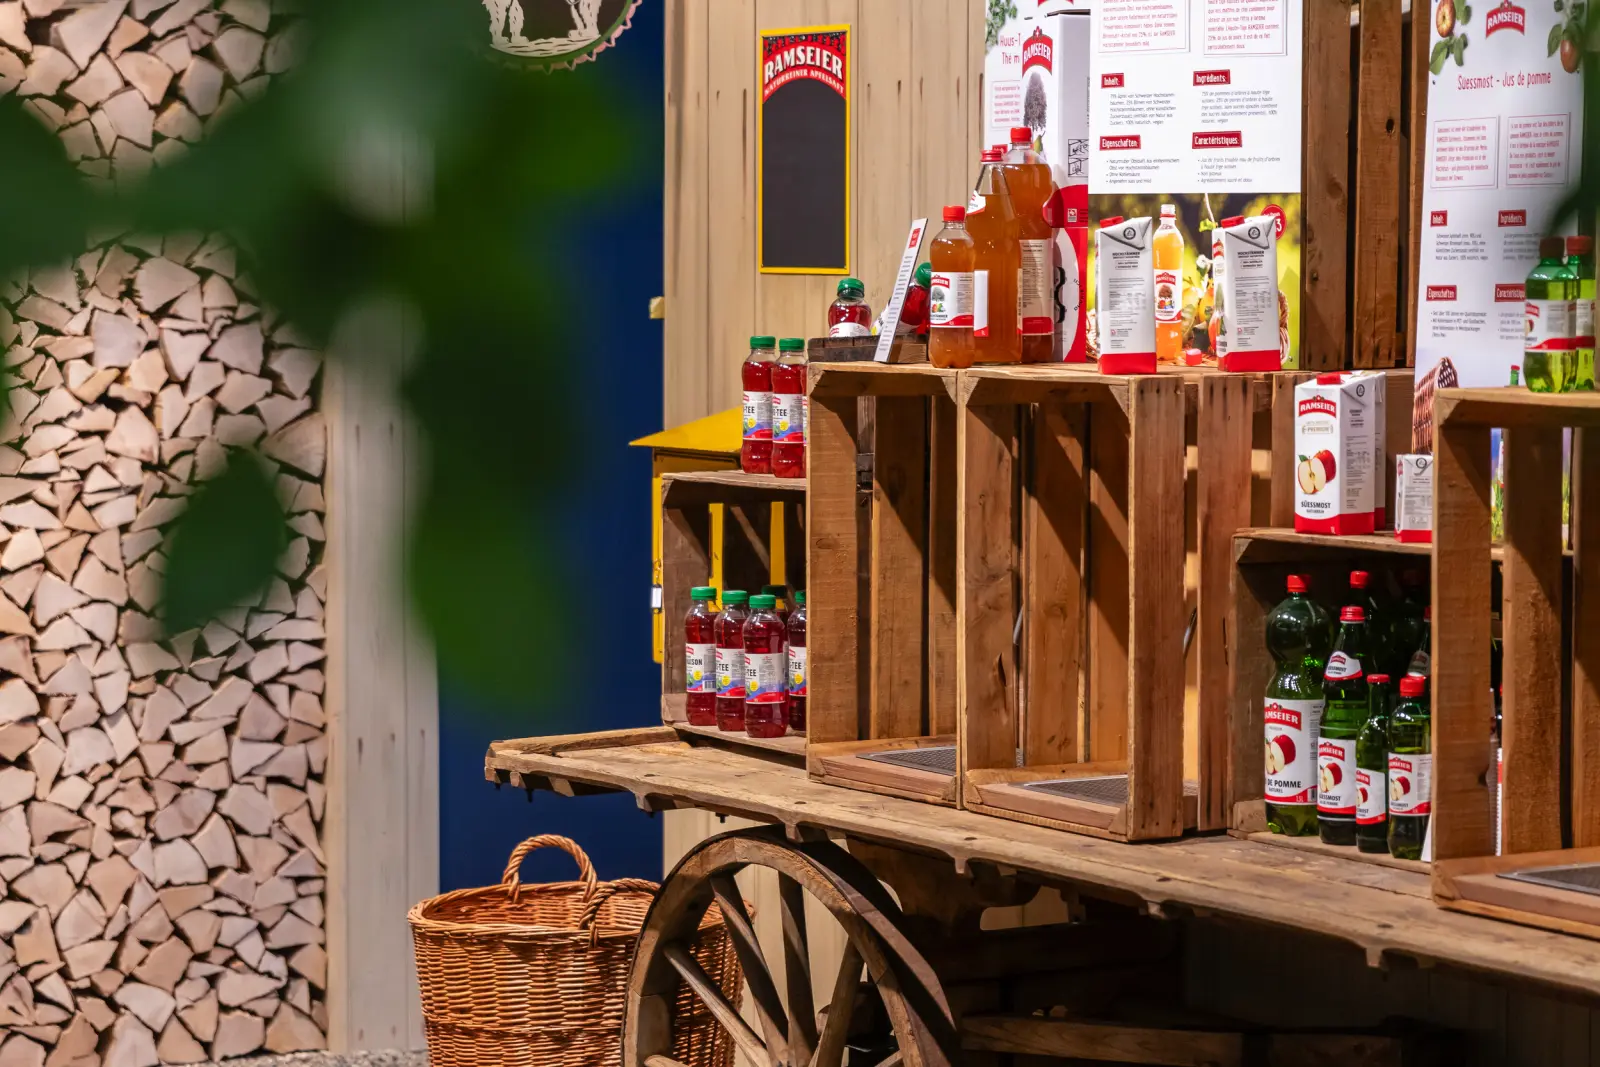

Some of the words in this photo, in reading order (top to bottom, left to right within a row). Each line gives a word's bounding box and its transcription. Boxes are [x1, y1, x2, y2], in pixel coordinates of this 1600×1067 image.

[1488, 12, 1523, 30] RAMSEIER
[1002, 52, 1011, 64] Thé
[1024, 43, 1051, 65] RAMSEIER
[764, 45, 843, 85] RAMSEIER
[764, 69, 808, 96] NATURREINER
[810, 69, 844, 94] APFELSAFT
[1502, 72, 1514, 87] Jus
[1518, 70, 1524, 86] de
[1527, 72, 1551, 88] pomme
[1300, 402, 1335, 412] RAMSEIER
[1301, 500, 1331, 508] SÜESSMOST
[1274, 780, 1301, 788] POMME
